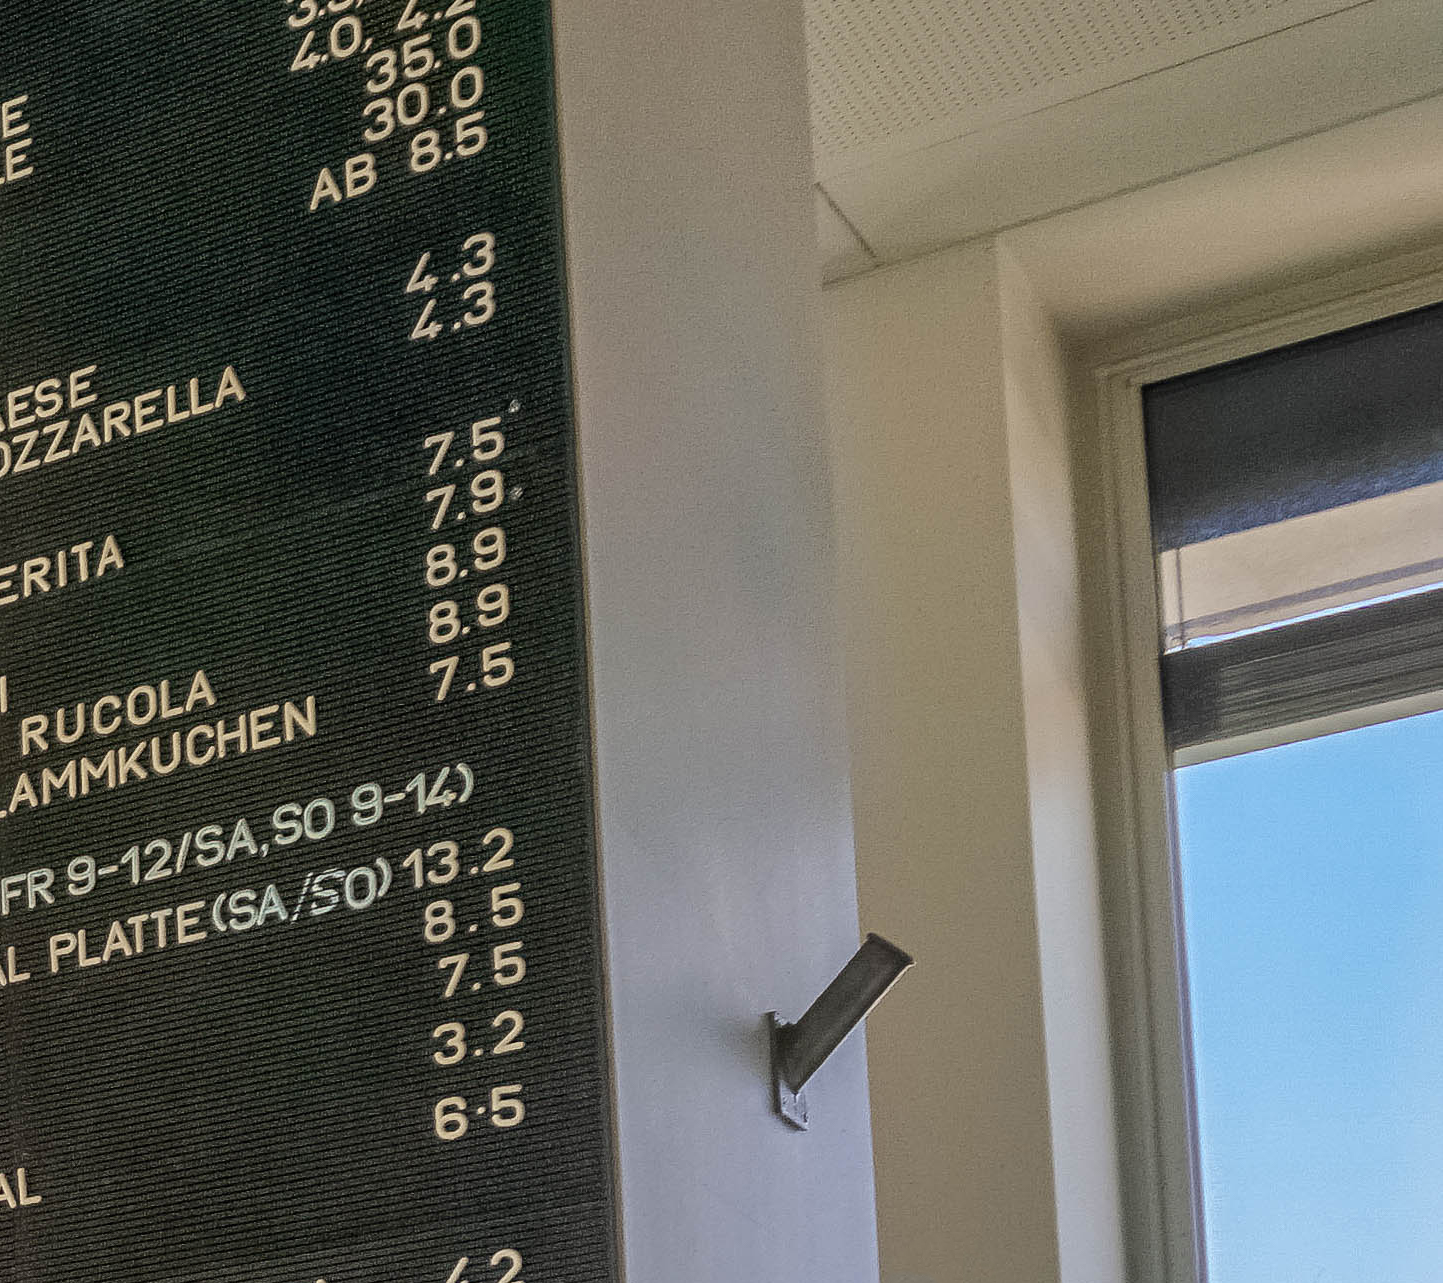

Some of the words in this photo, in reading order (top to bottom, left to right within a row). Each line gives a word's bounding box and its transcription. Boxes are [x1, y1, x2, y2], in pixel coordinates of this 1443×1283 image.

[365, 15, 481, 94] 35.0
[362, 66, 484, 142] 30.0
[309, 153, 377, 211] AB
[409, 111, 487, 173] 8.5
[405, 232, 495, 293] 4.3
[410, 281, 495, 340] 4.3
[423, 416, 505, 476] 7.5
[425, 469, 504, 530] 7.9
[425, 526, 506, 588] 8.9
[20, 669, 216, 756] RUCOLA
[428, 583, 510, 644] 8.9
[429, 641, 514, 702] 7.5
[350, 762, 474, 827] 9-14)
[401, 827, 514, 889] 13.2
[423, 882, 524, 944] 8.5
[437, 941, 526, 998] 7.5
[432, 1009, 525, 1066] 3.2
